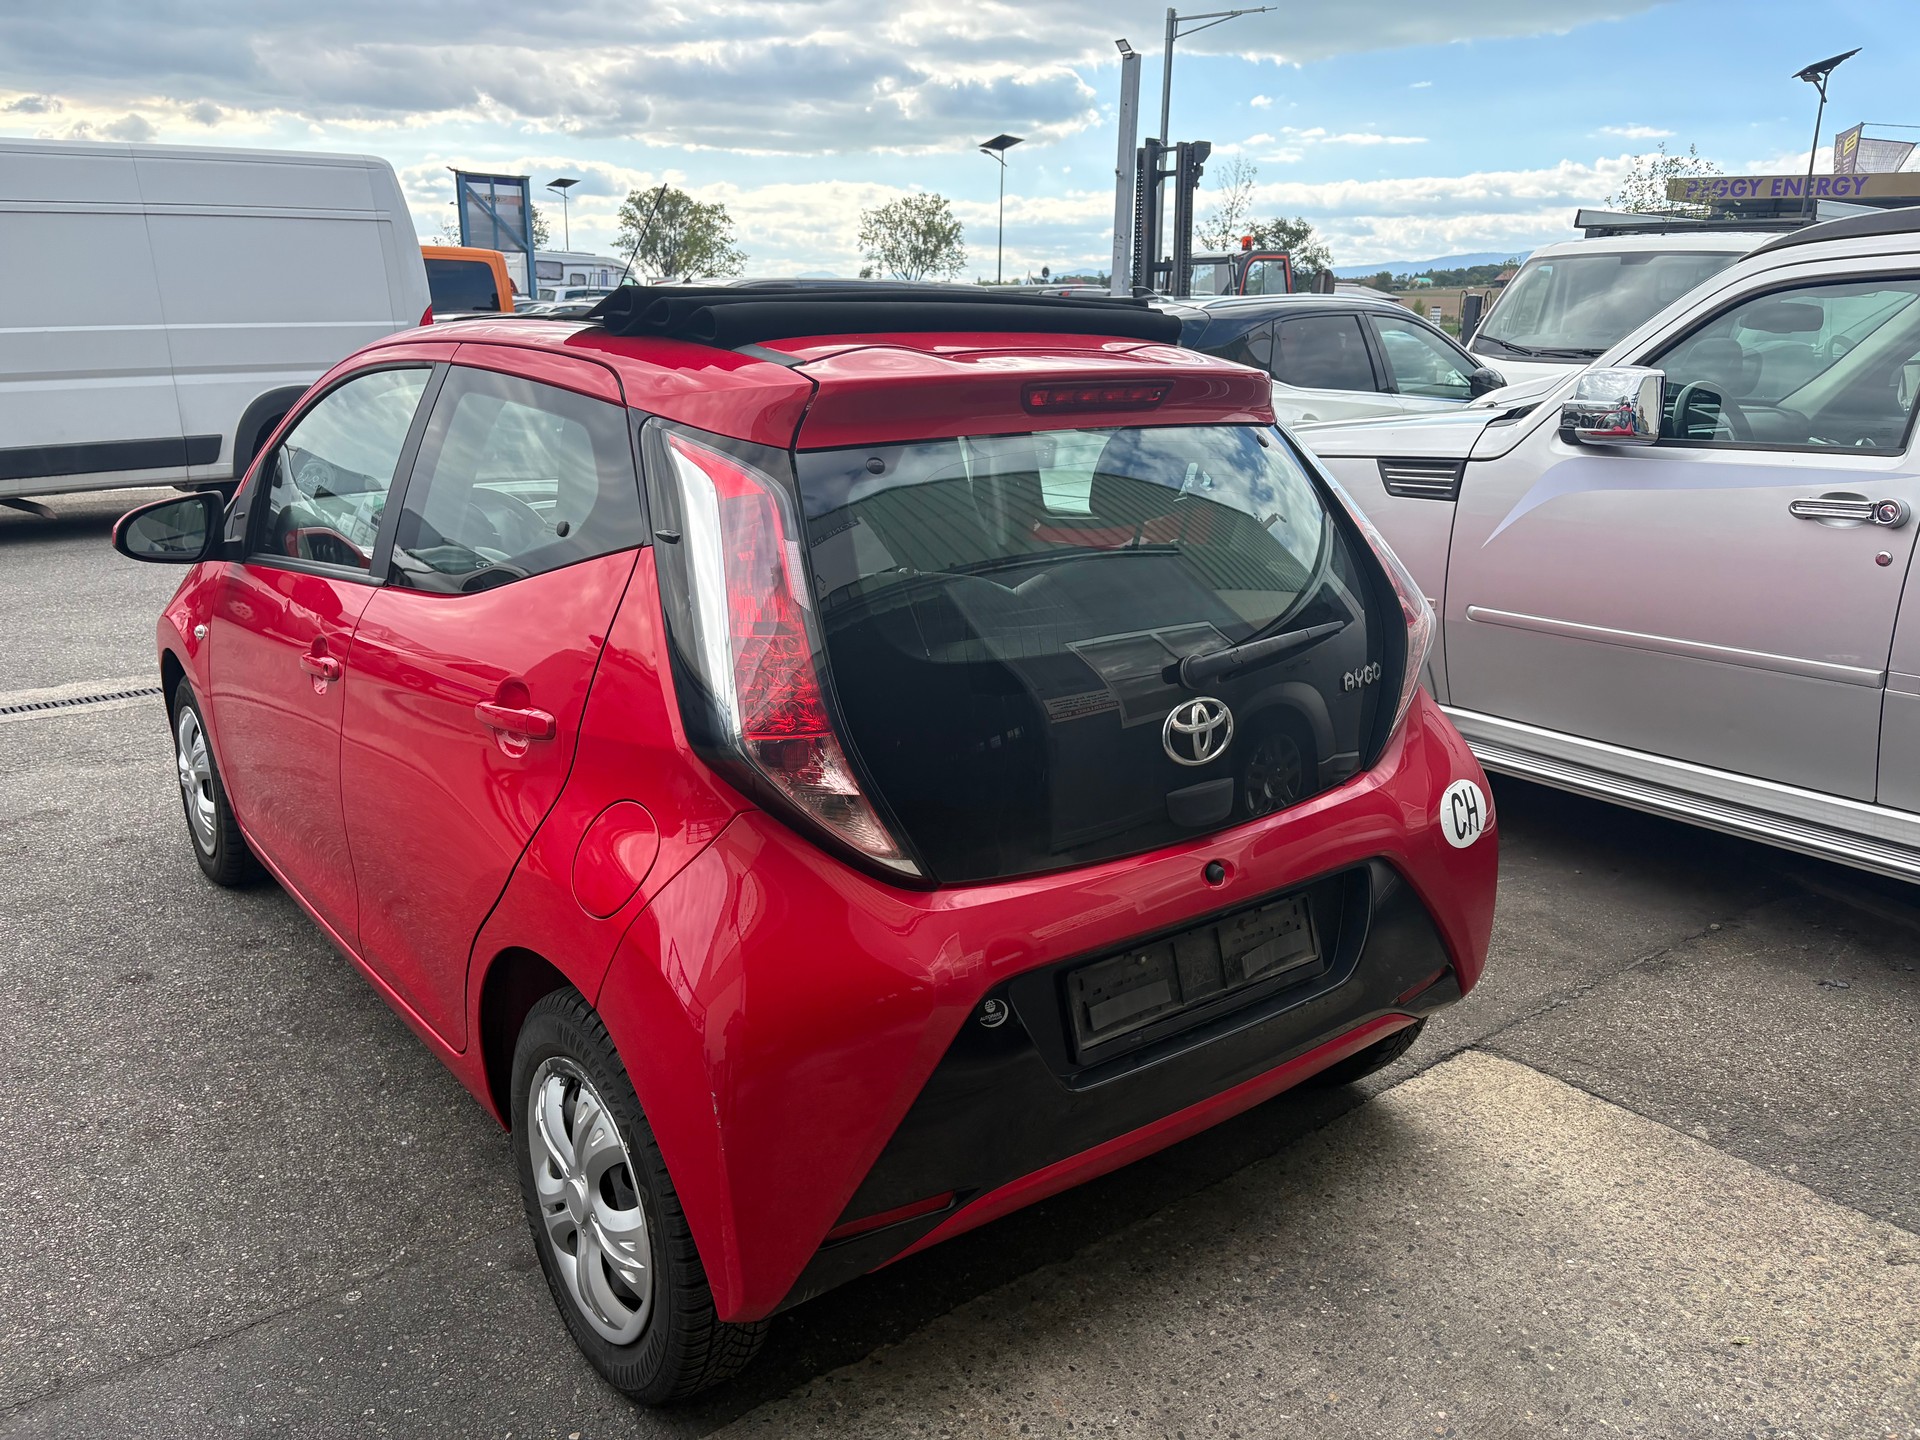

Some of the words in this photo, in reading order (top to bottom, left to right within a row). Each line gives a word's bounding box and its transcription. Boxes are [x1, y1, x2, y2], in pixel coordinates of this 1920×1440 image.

[1685, 178, 1763, 198] PEGGY
[1771, 176, 1870, 197] ENERGY
[1343, 661, 1381, 692] AYGO
[1451, 785, 1480, 840] CH
